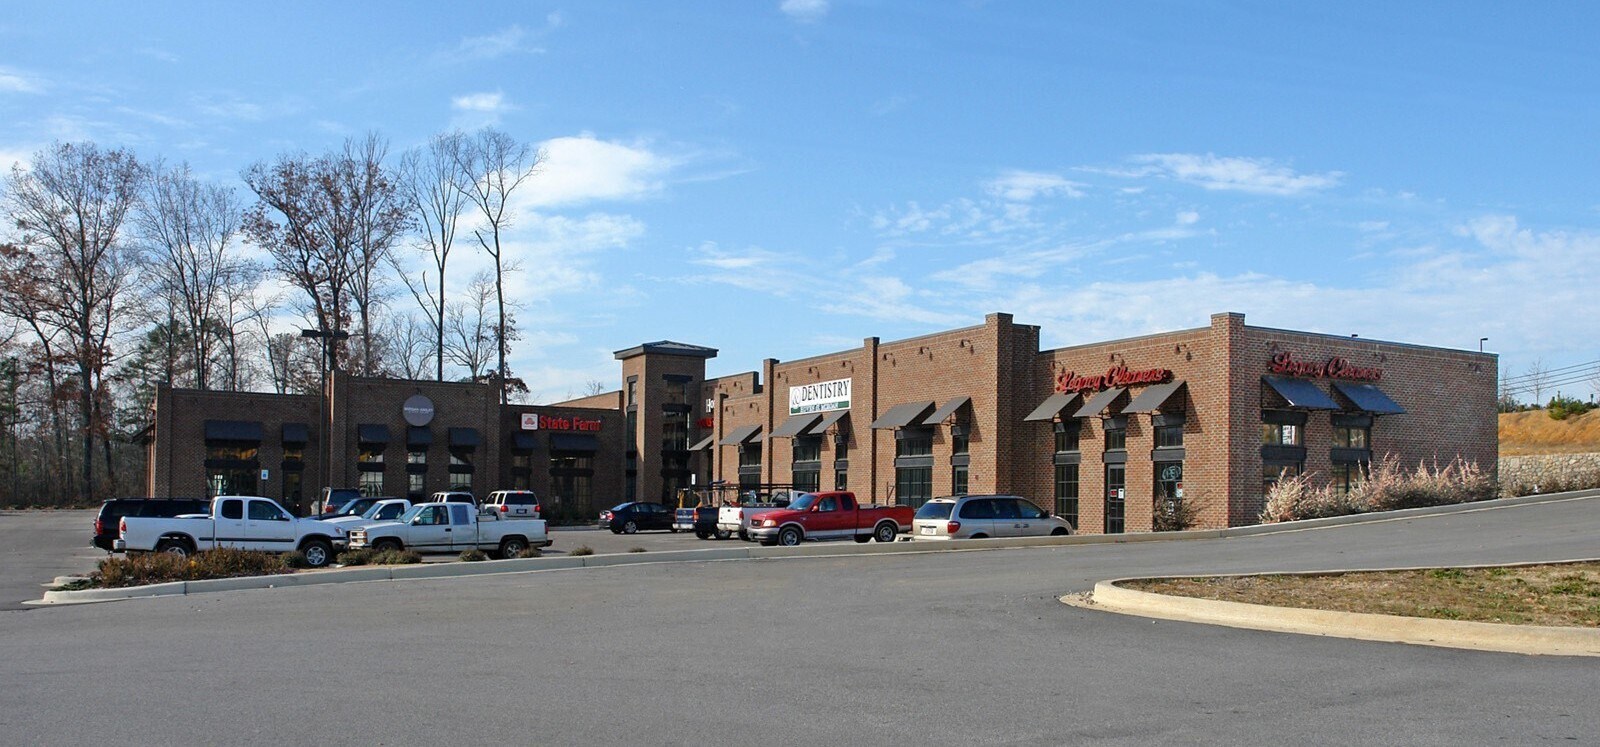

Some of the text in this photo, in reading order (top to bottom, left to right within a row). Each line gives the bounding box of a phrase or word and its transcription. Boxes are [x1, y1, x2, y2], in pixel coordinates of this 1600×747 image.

[802, 380, 849, 401] DENTISTRY
[1056, 371, 1102, 393] Legacy
[539, 415, 601, 431] State Farm
